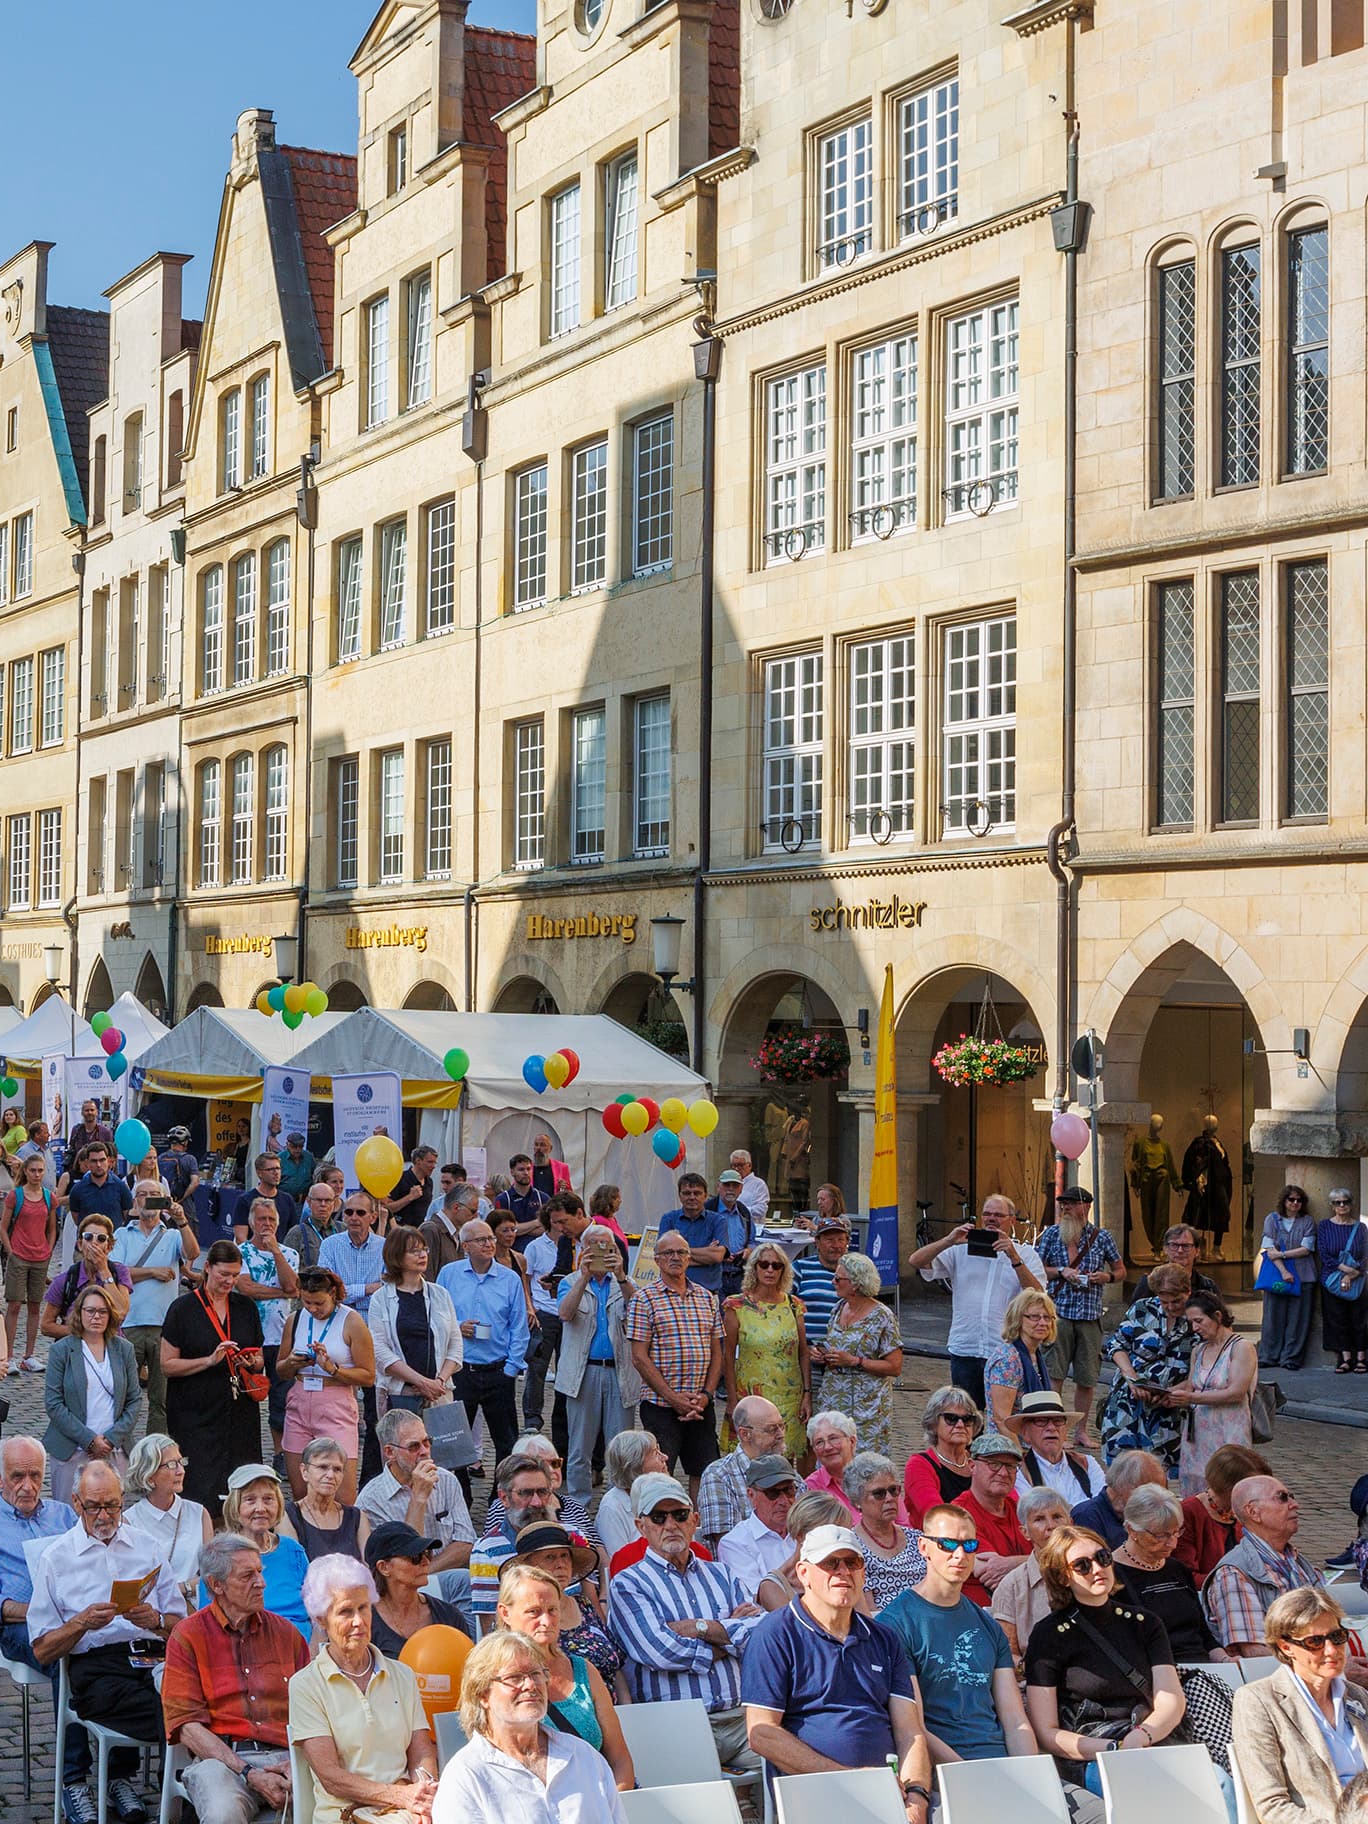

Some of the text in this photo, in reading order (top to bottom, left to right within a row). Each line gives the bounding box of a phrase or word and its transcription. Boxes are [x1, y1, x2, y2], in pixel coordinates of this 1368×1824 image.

[810, 894, 928, 931] schnitzler
[345, 924, 428, 952] Harenberg
[527, 911, 637, 944] Harenberg
[205, 933, 273, 958] Harenberg
[215, 1111, 232, 1123] des
[216, 1129, 238, 1143] offe
